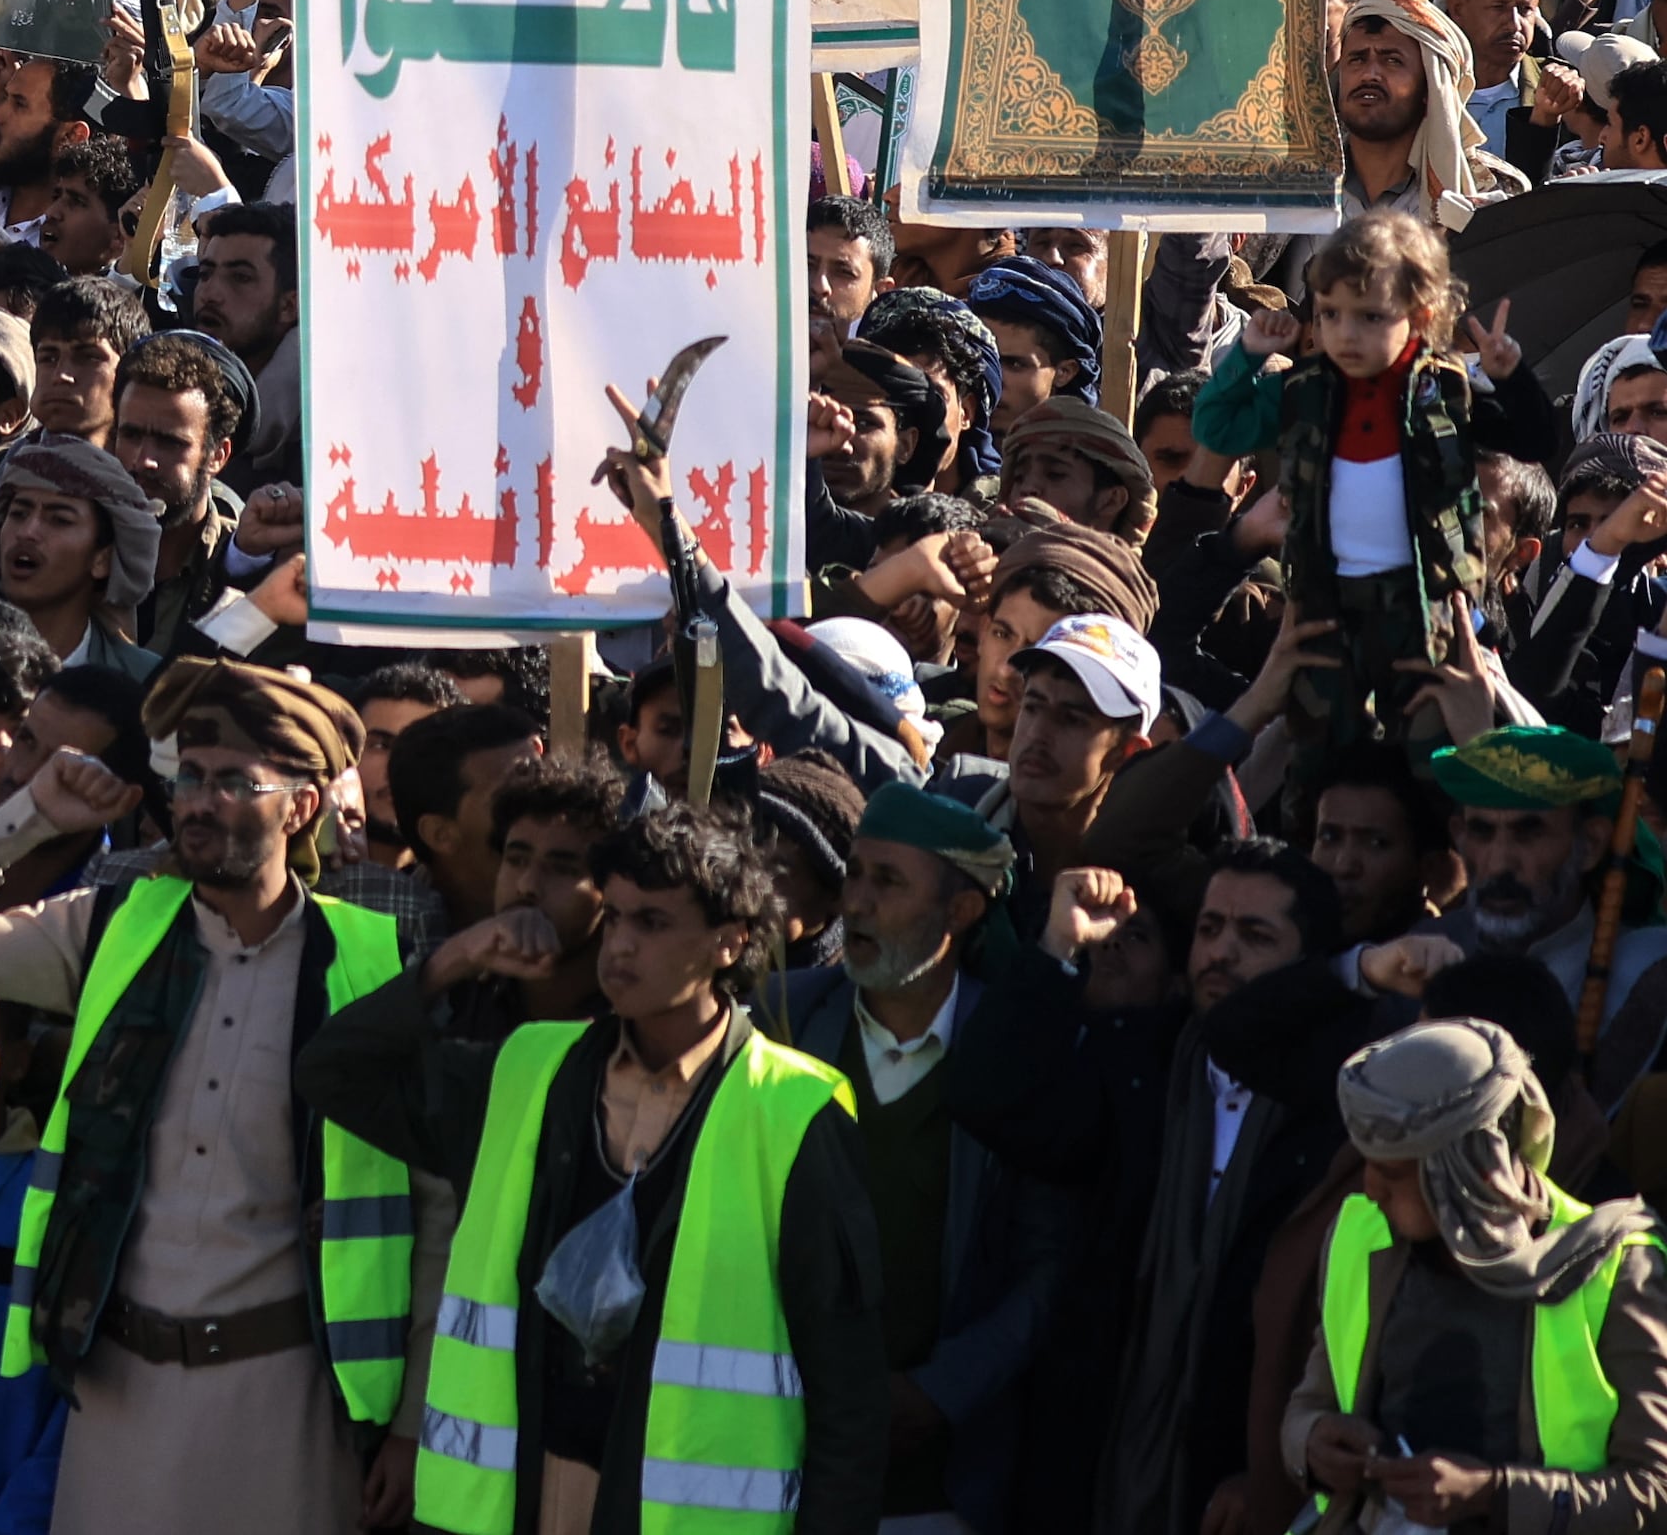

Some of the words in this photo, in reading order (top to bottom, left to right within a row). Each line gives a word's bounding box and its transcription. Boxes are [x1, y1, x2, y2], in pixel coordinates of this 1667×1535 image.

[313, 128, 537, 283] الأمريكية
[559, 137, 767, 290] البضائع
[513, 296, 543, 408] و
